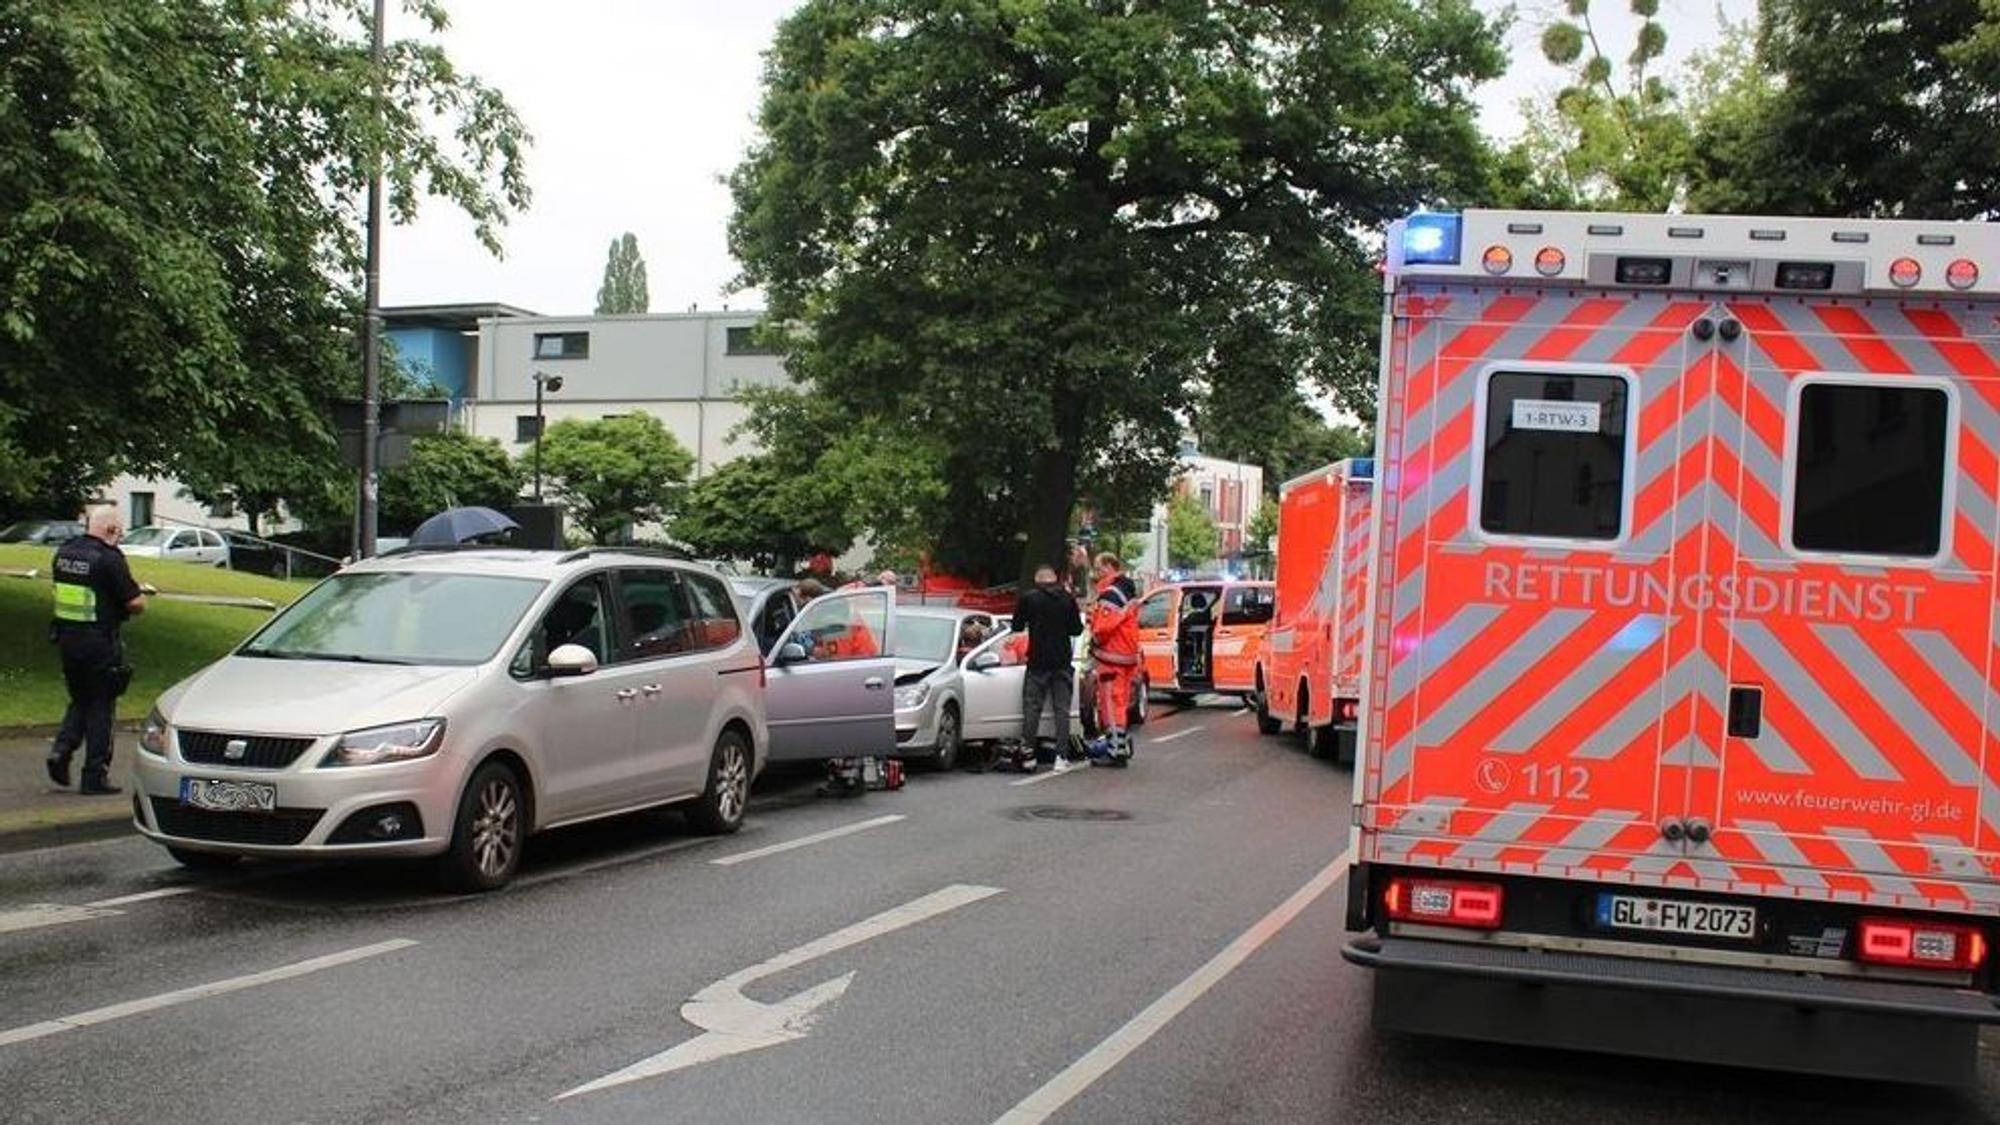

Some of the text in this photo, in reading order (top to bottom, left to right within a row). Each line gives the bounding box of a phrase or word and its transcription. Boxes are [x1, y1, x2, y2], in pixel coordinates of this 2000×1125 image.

[1484, 561, 1926, 622] RETTUNGSDIENST
[1521, 762, 1590, 800] 112
[1736, 788, 1963, 822] www.feuerwehr-gl.de
[1613, 899, 1643, 925] GL
